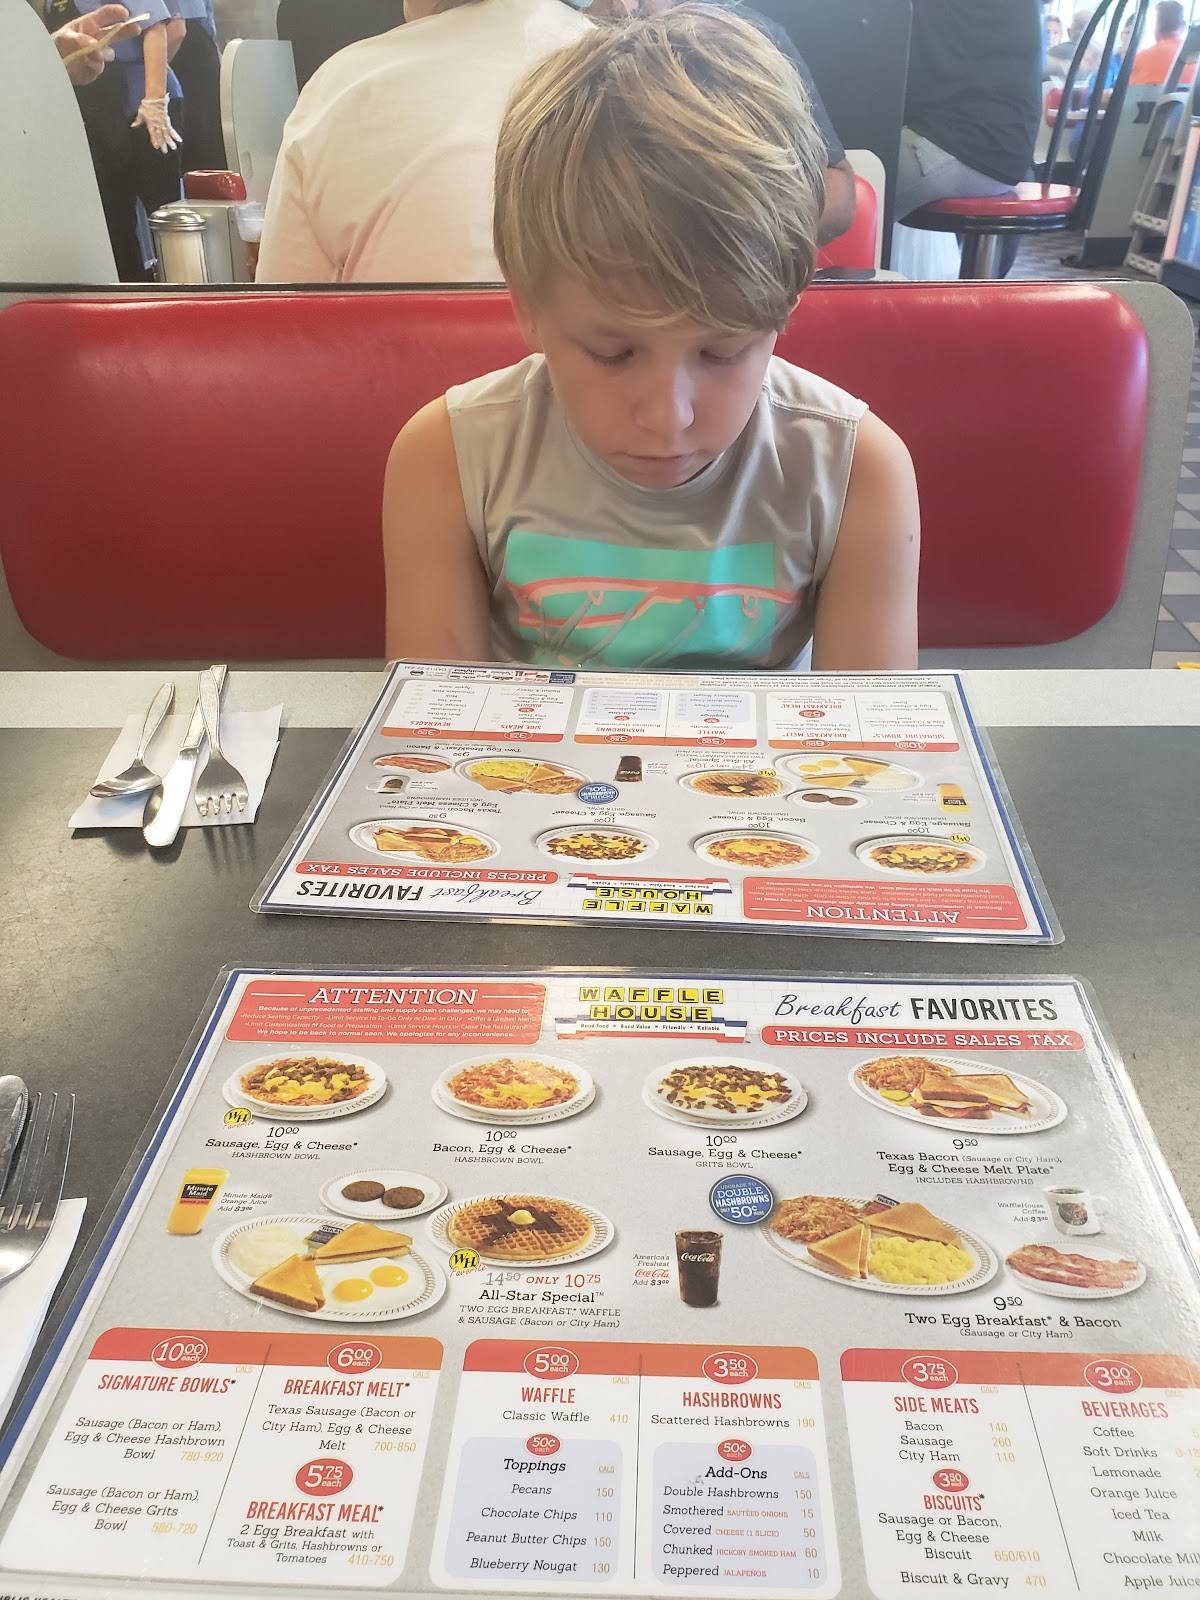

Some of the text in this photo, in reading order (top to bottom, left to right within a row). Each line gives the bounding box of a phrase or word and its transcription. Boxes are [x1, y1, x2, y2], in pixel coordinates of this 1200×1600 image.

[306, 864, 547, 881] PRICES INCLUDE SALES TAX
[296, 880, 543, 905] Breakfast FAVORITES
[595, 887, 702, 902] HOUSE
[582, 899, 712, 915] WAFFLE
[806, 905, 960, 924] ATTENTION
[308, 987, 478, 1005] ATTENTION
[581, 987, 723, 1004] WAFFLE
[591, 1005, 711, 1021] HOUSE
[774, 994, 1057, 1024] Breakfast FAVORITES
[775, 1031, 1072, 1046] PRICES INCLUDE SALES TAX
[205, 1138, 260, 1150] Sausage,
[264, 1140, 289, 1151] Egg
[293, 1141, 302, 1150] &
[433, 1143, 474, 1155] Bacon,
[478, 1144, 503, 1156] Egg
[508, 1145, 518, 1154] &
[231, 1151, 320, 1160] HASHBROWN BOWL
[454, 1156, 544, 1165] HASHBROWN BOWL
[648, 1147, 704, 1159] Sausage,
[709, 1148, 734, 1160] Egg
[738, 1149, 747, 1158] &
[876, 1151, 914, 1162] Texas
[918, 1152, 959, 1162] Bacon
[1015, 1155, 1032, 1165] City
[696, 1160, 754, 1169] GRITS BOWL
[888, 1163, 914, 1176] Egg
[918, 1164, 929, 1174] &
[933, 1164, 982, 1175] Cheese
[984, 1164, 1014, 1175] Melt
[185, 1184, 214, 1192] Minute
[915, 1177, 1034, 1186] INCLUDES HASHBROWNS
[188, 1190, 209, 1198] Maid
[716, 1186, 763, 1198] DOUBLE
[220, 1198, 268, 1206] Orange Juice
[715, 1194, 770, 1208] HASHBROWNS
[637, 1260, 670, 1268] Freshest
[478, 1290, 537, 1301] All-Star
[460, 1305, 485, 1314] TWO
[487, 1305, 509, 1315] EGG
[579, 1307, 621, 1317] WAFFLE
[458, 1316, 465, 1324] &
[467, 1316, 517, 1326] SAUSAGE
[520, 1317, 554, 1328] (Bacon
[569, 1318, 591, 1330] City
[593, 1319, 621, 1329] Ham)
[904, 1313, 936, 1325] Two
[940, 1313, 970, 1327] Egg
[1059, 1316, 1070, 1327] &
[1074, 1316, 1122, 1329] Bacon
[959, 1328, 1006, 1340] (Sausage
[1021, 1329, 1043, 1341] City
[1045, 1330, 1074, 1340] Ham)
[97, 1374, 178, 1393] SIGNATURE
[283, 1378, 364, 1396] BREAKFAST
[521, 1386, 576, 1404] WAFFLE
[682, 1391, 782, 1409] HASHBROWNS
[893, 1395, 980, 1414] SIDE MEATS
[1081, 1400, 1169, 1419] BEVERAGES
[502, 1410, 590, 1422] Classic Waffle
[651, 1414, 790, 1428] Scattered Hashbrowns
[904, 1420, 944, 1432] Bacon
[1092, 1426, 1135, 1438] Coffee
[63, 1431, 225, 1447] Egg & Cheese Hashbrown
[900, 1435, 954, 1448] Sausage
[123, 1448, 156, 1460] Bowl
[898, 1450, 961, 1463] City Ham
[1083, 1446, 1158, 1459] Soft Drinks
[503, 1458, 567, 1473] Toppings
[1091, 1466, 1162, 1478] Lemonade
[704, 1466, 768, 1480] Add-Ons
[511, 1484, 552, 1495] Pecans
[596, 1487, 614, 1498] 150
[663, 1485, 779, 1500] Double Hashbrowns
[1090, 1486, 1178, 1502] Orange Juice
[245, 1500, 335, 1521] BREAKFAST
[481, 1507, 613, 1522] Chocolate Chips 110
[662, 1504, 724, 1516] Smothered
[1111, 1508, 1170, 1520] Iced Tea
[239, 1525, 375, 1539] 2 Egg Breakfast with
[662, 1523, 712, 1536] Covered
[1132, 1529, 1164, 1542] Milk
[466, 1531, 612, 1548] Peanut Butter Chips 150
[662, 1543, 713, 1556] Chunked
[275, 1553, 328, 1564] Tomatoes
[470, 1557, 610, 1574] Blueberry Nougat 130
[1103, 1552, 1173, 1565] Chocolate
[662, 1563, 720, 1577] Peppered
[900, 1571, 1010, 1588] Biscuit & Gravy
[1123, 1575, 1164, 1590] Apple
